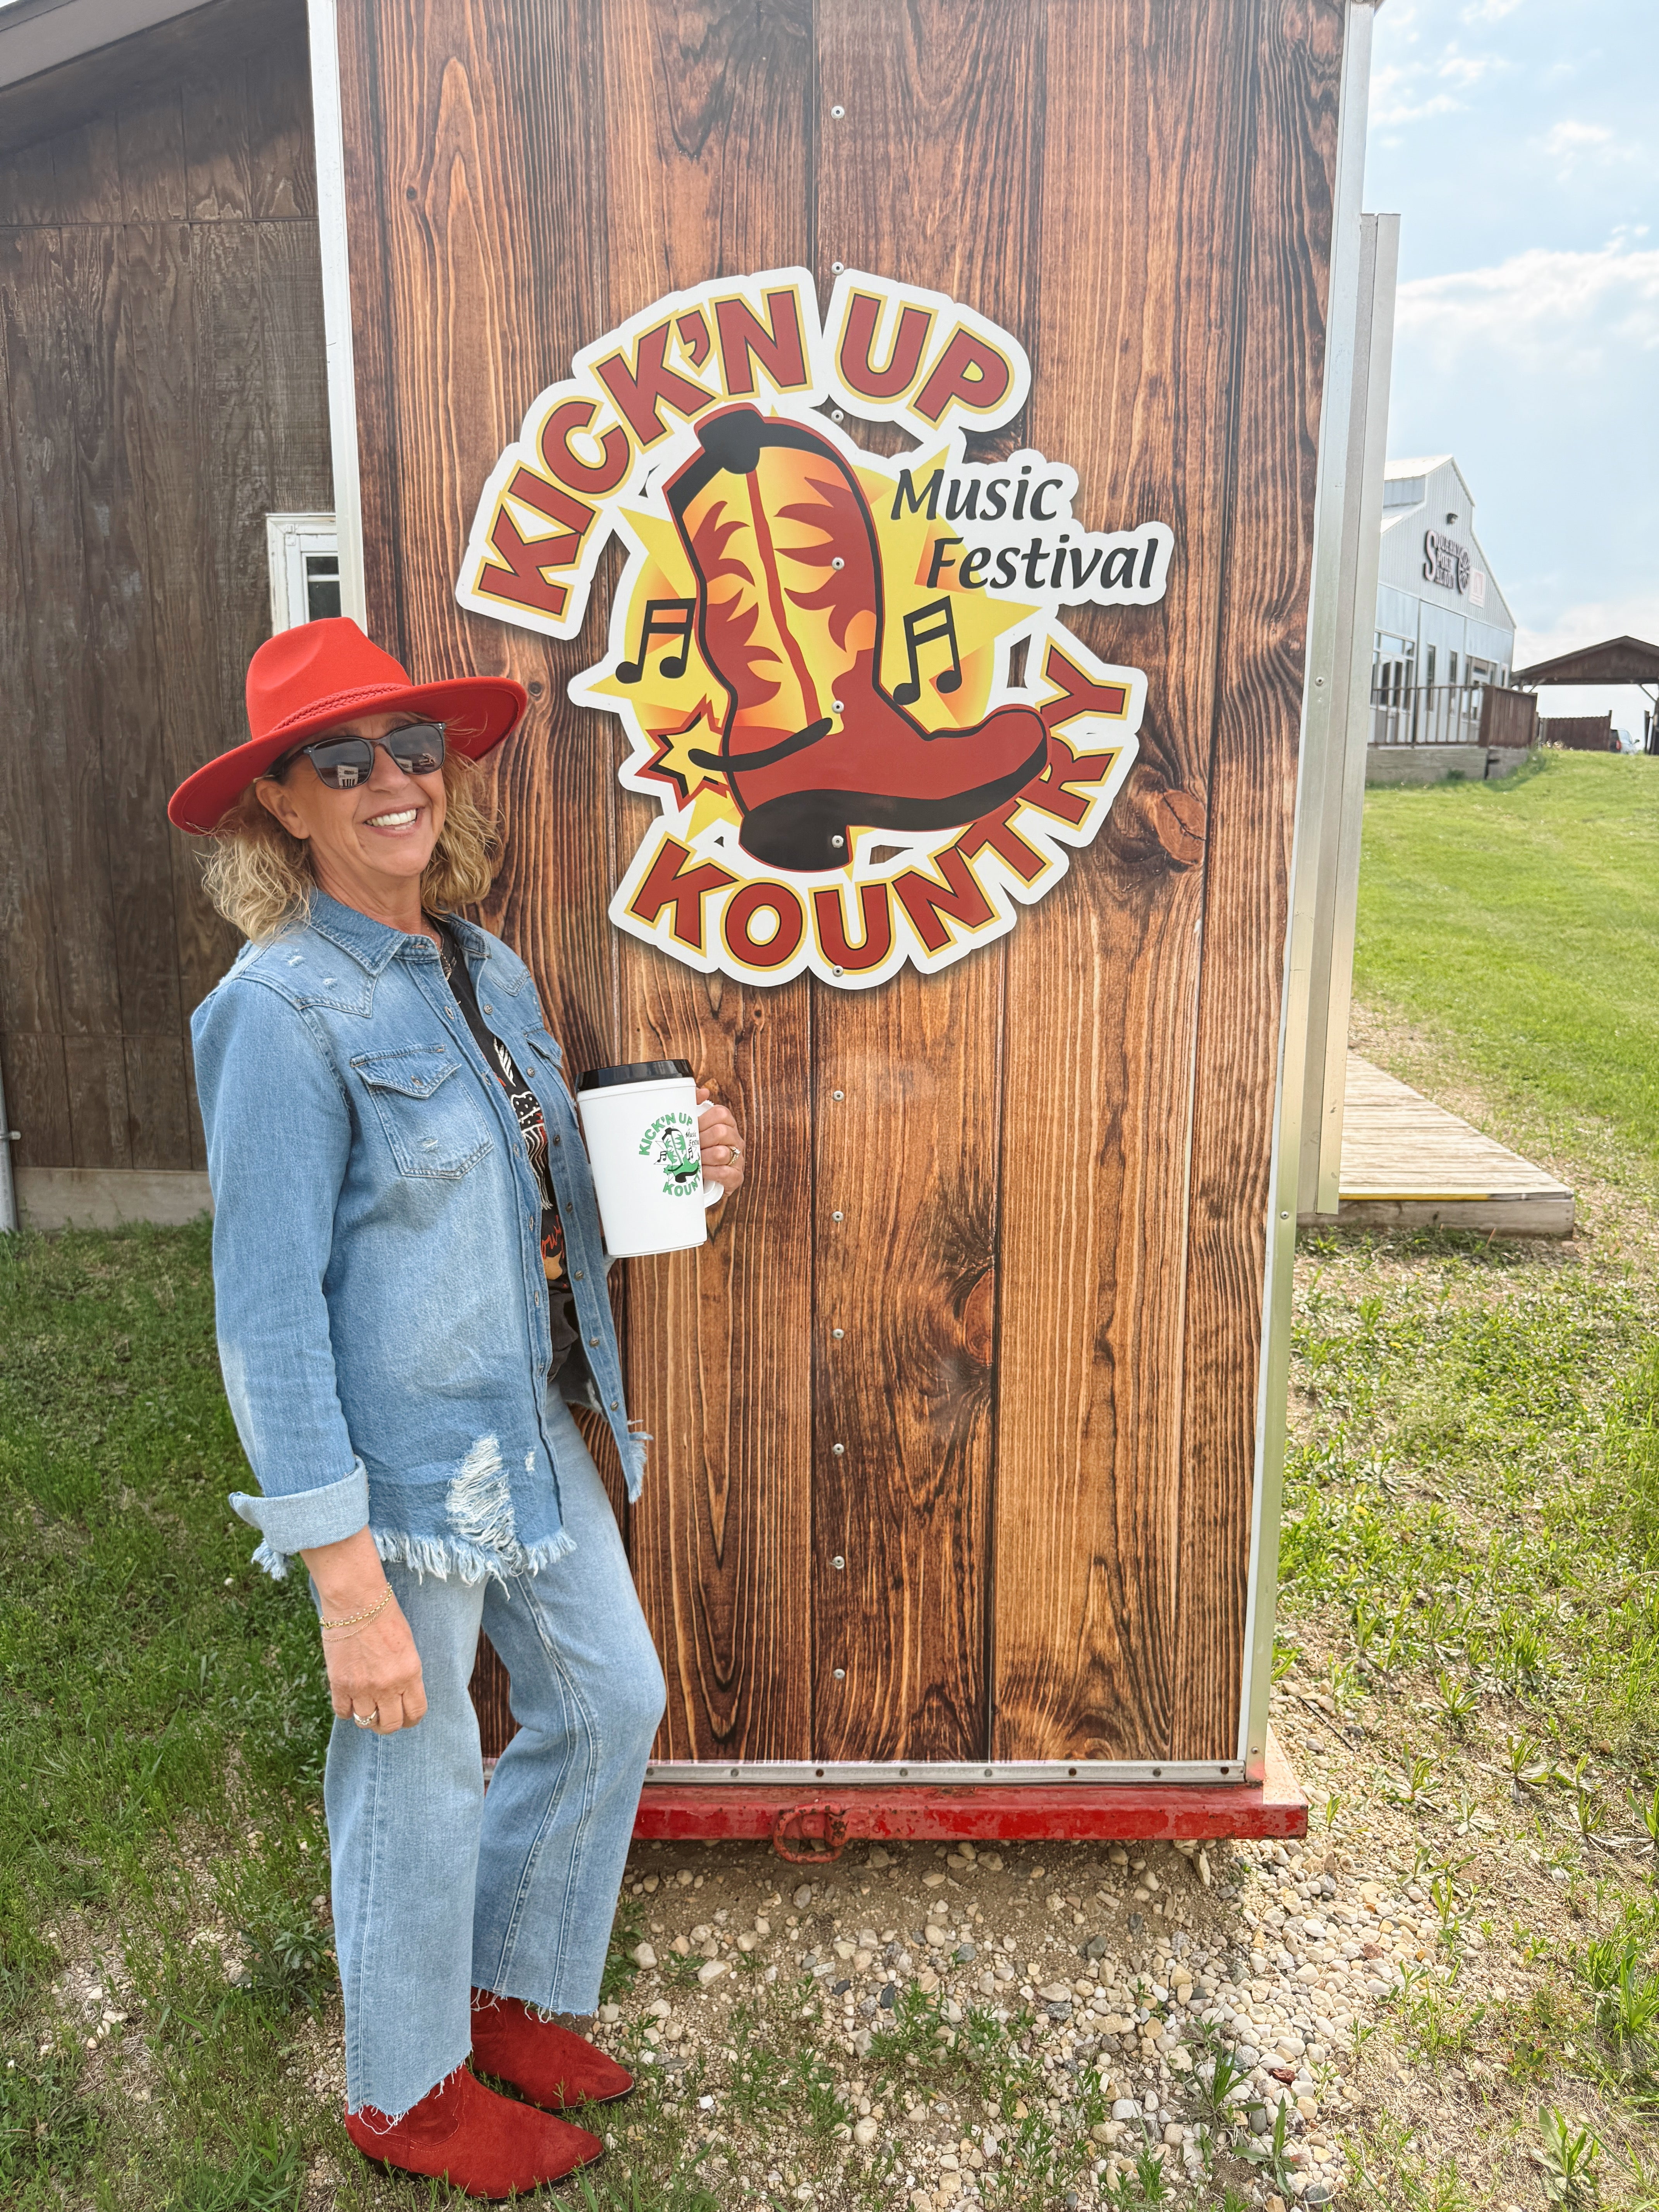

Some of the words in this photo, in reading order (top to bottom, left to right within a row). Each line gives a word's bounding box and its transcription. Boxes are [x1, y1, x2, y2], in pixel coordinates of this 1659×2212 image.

[471, 283, 812, 623] KICK'N
[835, 286, 1015, 430] UP
[890, 466, 1063, 520] Music
[927, 534, 1159, 589] Festival
[624, 634, 1132, 974] KOUNTRY
[639, 1113, 676, 1155] KICK'N
[679, 1112, 692, 1126] UP
[685, 1128, 697, 1137] Music
